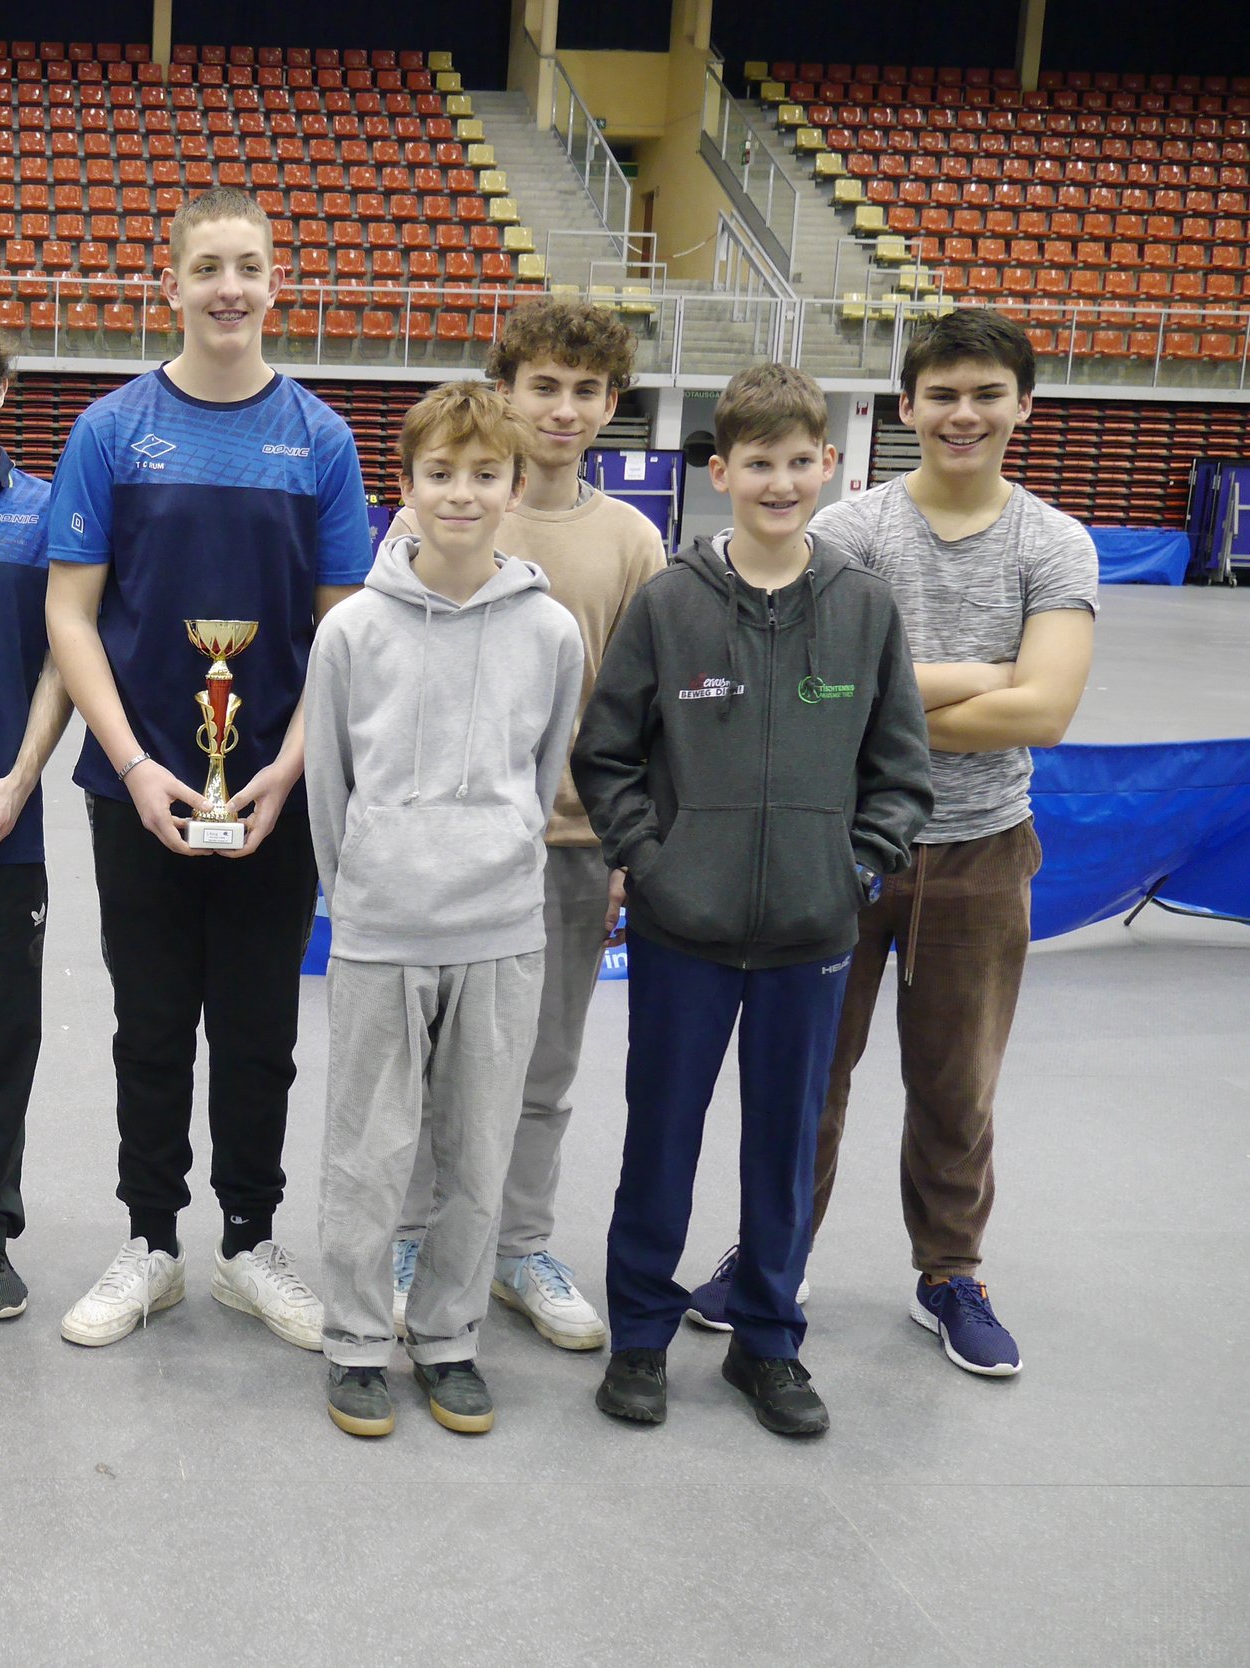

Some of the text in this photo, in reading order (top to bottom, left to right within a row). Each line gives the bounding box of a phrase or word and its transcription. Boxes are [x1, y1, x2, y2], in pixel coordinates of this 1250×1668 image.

[685, 391, 720, 399] OTAUSGA
[261, 444, 311, 457] DONIC
[681, 686, 744, 698] BEWEG DI!
